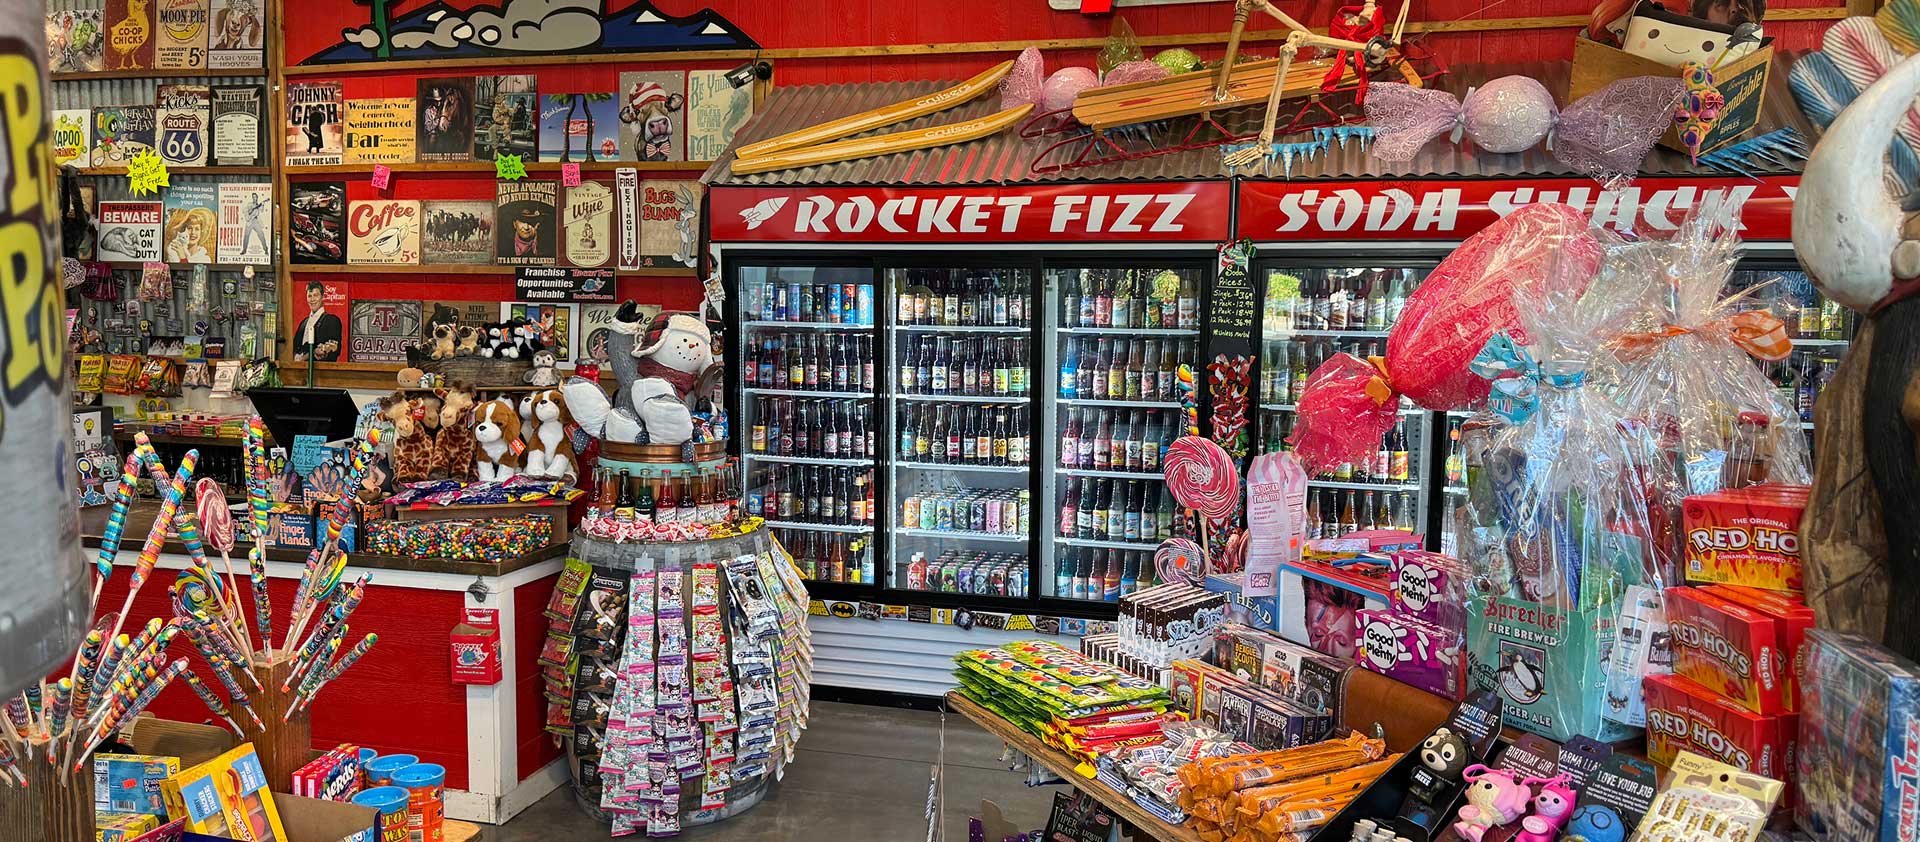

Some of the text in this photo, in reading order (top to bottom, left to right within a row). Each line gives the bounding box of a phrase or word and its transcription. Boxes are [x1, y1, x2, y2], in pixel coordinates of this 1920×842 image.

[118, 27, 142, 36] CO-OP
[114, 36, 143, 45] CHICKS
[294, 88, 336, 102] JOHNNY
[165, 94, 200, 112] Kicks
[348, 102, 383, 110] Welcome
[168, 119, 196, 128] ROUTE
[348, 120, 412, 129] Neighborhood
[1720, 120, 1740, 134] APPLES
[167, 132, 196, 158] 66
[347, 132, 382, 148] Bar
[133, 160, 144, 170] Buy
[133, 166, 160, 180] Signs Get
[147, 178, 162, 186] Free
[498, 182, 556, 194] NEVER APOLOGIZE
[620, 178, 635, 188] FIRE
[509, 193, 529, 202] NEVER
[530, 193, 556, 207] EXPLAIN
[645, 188, 676, 204] BUGS
[104, 212, 158, 223] BEWARE
[224, 206, 240, 224] ELVIS
[572, 200, 604, 220] Wine
[642, 206, 684, 222] BUNNY
[794, 194, 1196, 233] ROCKET FIZZ
[1276, 188, 1460, 233] SODA
[350, 202, 416, 238] Coffee
[140, 229, 155, 238] CAT
[220, 228, 243, 246] PRESLEY
[141, 240, 152, 248] ON
[136, 250, 158, 258] DUTY
[525, 268, 566, 277] Franchise
[1225, 265, 1244, 276] Soda
[325, 284, 336, 294] Soy
[517, 278, 574, 288] Opportunities
[1218, 277, 1246, 287] Prices:
[526, 290, 565, 300] Available
[1214, 290, 1233, 299] Single
[1217, 308, 1233, 316] Pack
[348, 466, 366, 500] Unicorn
[280, 522, 306, 534] Finger
[1749, 518, 1789, 530] ORIGINAL
[280, 533, 310, 546] Hands
[1690, 528, 1801, 554] RED HO
[1752, 555, 1786, 564] FLAVORED
[1402, 570, 1427, 588] Good
[1400, 586, 1428, 606] Plenty
[1236, 593, 1272, 625] HEAD
[1484, 597, 1566, 631] Sprecher
[1006, 622, 1034, 630] WARS
[1366, 628, 1394, 648] Good
[1488, 622, 1558, 646] FIRE BREWED
[1235, 643, 1258, 656] BEAGLE
[1366, 642, 1396, 664] Plenty
[1671, 622, 1700, 646] RED
[1702, 630, 1750, 678] HOTS
[1234, 652, 1258, 667] SCOUTS
[1761, 646, 1773, 690] RED HOTS
[1223, 696, 1249, 718] PANTHER
[1458, 701, 1478, 716] MASCOT
[1260, 714, 1288, 730] GALAXY
[1532, 712, 1552, 729] ALE
[1688, 708, 1716, 727] ORIGINAL
[1114, 735, 1165, 748] ZAGNUT
[1650, 710, 1687, 737] RED
[1692, 724, 1750, 772] HOTS
[1506, 744, 1538, 769] BIRTHDAY
[1538, 755, 1556, 774] GIRL
[1680, 758, 1701, 769] Funny
[1762, 744, 1771, 768] HOTS
[322, 762, 355, 801] Nerds
[1598, 770, 1618, 788] LOVE
[1617, 777, 1638, 792] YOUR
[1636, 782, 1655, 799] JOB
[198, 790, 210, 816] CRACKER
[204, 784, 218, 811] STACKERS
[1054, 806, 1078, 832] VIPER
[1057, 823, 1076, 838] BLAST
[1082, 828, 1103, 842] LIQUID
